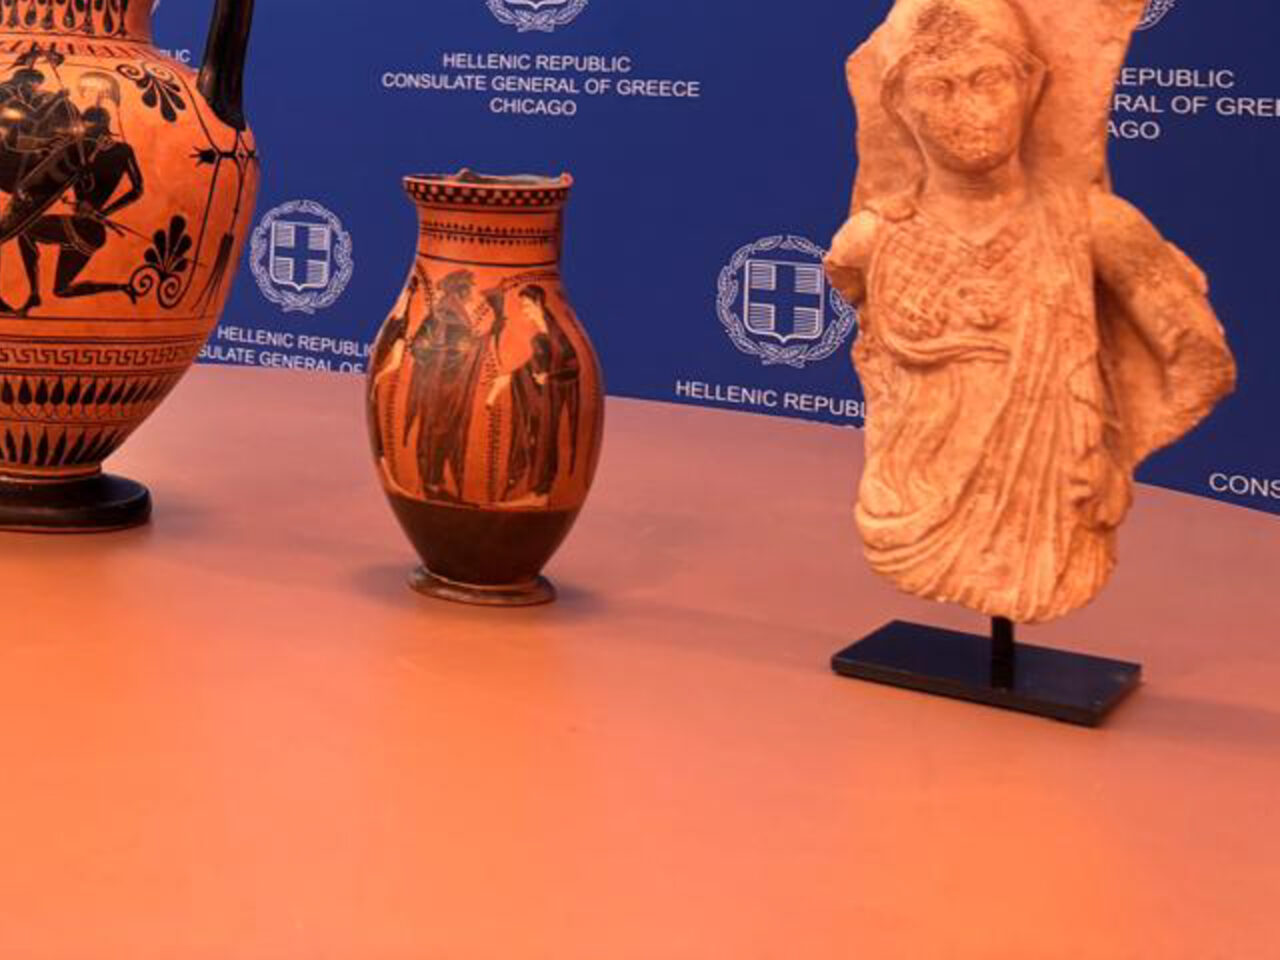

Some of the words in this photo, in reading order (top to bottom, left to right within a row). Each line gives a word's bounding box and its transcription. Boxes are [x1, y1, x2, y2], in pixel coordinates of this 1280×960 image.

[443, 53, 530, 70] HELLENIC
[536, 55, 630, 72] REPUBLIC
[382, 72, 486, 90] CONSULATE
[491, 76, 580, 94] GENERAL
[584, 78, 611, 94] OF
[616, 79, 699, 97] GREECE
[1115, 67, 1236, 89] EPUBLIC
[490, 97, 576, 115] CHICAGO
[1170, 95, 1210, 114] OF
[217, 326, 294, 349] HELLENIC
[675, 380, 778, 407] HELLENIC
